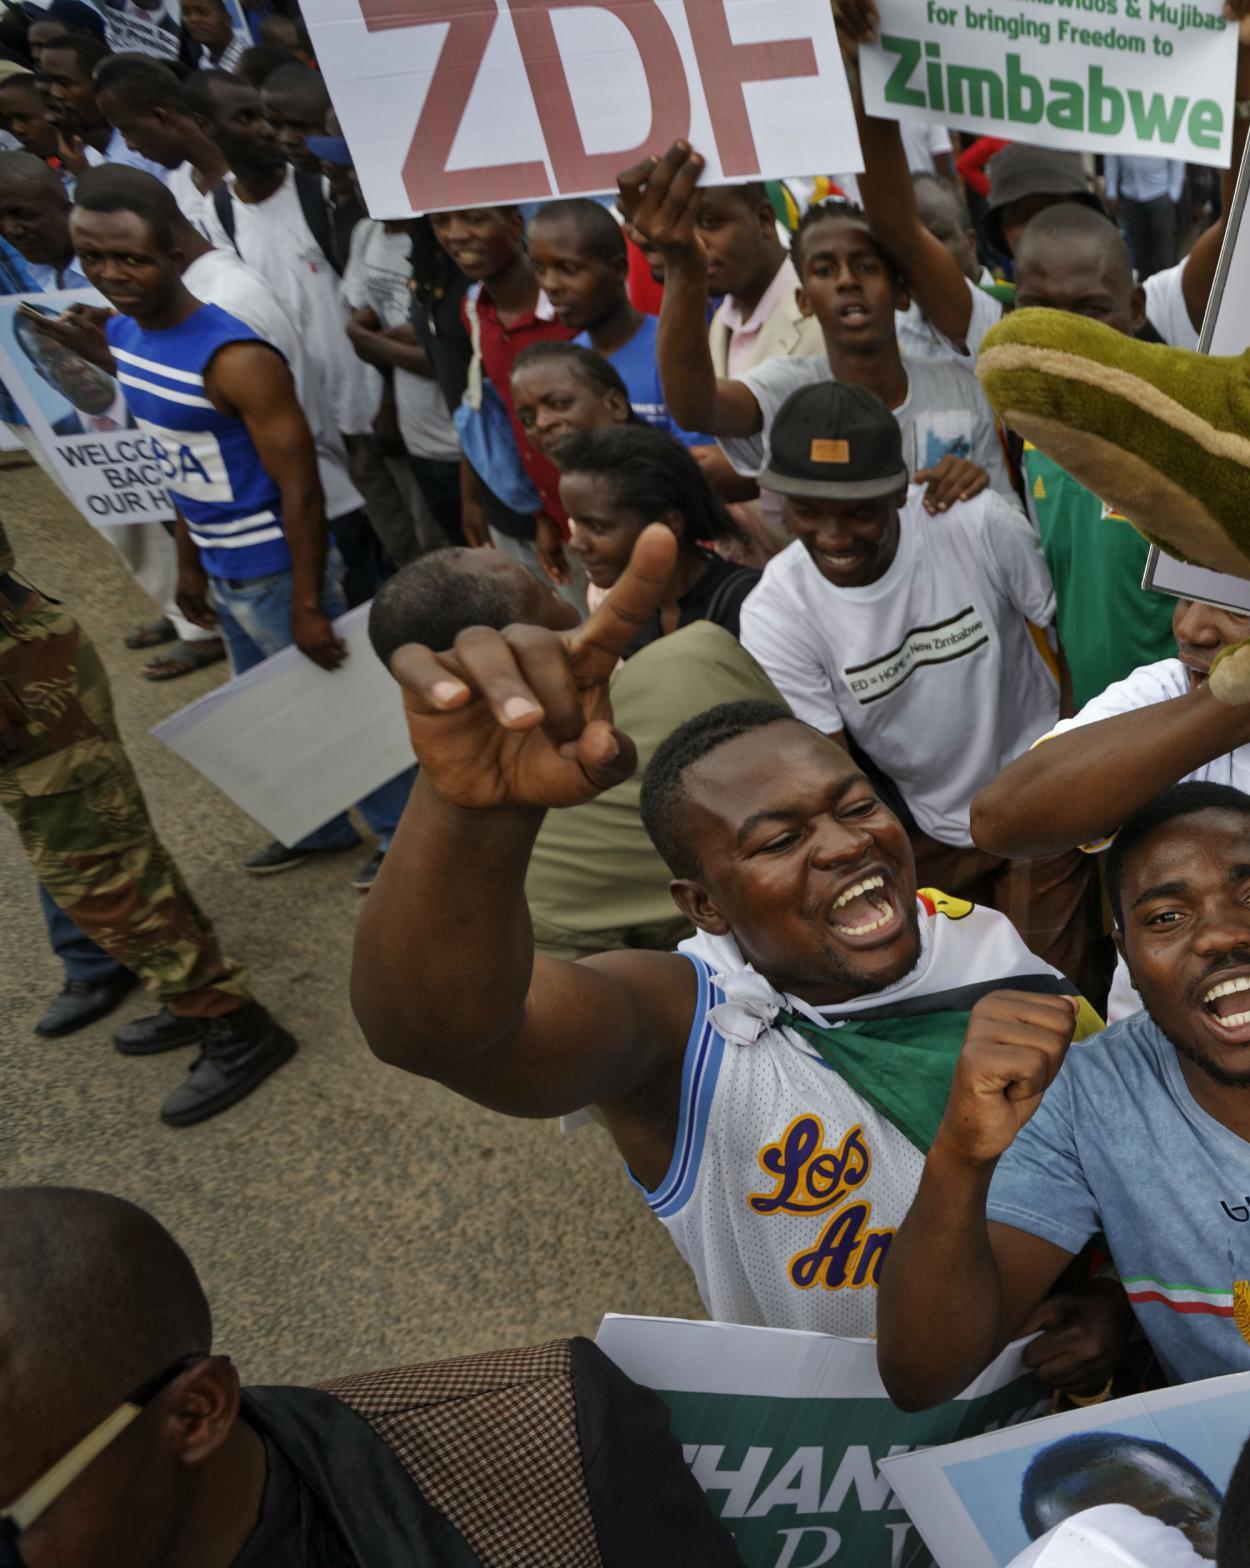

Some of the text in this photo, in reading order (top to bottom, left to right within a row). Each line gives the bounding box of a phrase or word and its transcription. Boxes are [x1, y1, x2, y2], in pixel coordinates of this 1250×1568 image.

[927, 0, 1174, 57] for bringing Freedom to
[1125, 0, 1141, 19] &
[1149, 2, 1227, 31] Mujibas
[358, 0, 820, 212] ZDF
[880, 33, 1224, 150] Zimbabwe
[56, 437, 152, 468] WELCO
[102, 463, 163, 490] BAC
[86, 490, 148, 516] OUR
[850, 678, 869, 693] ED
[879, 659, 908, 684] HOPE
[909, 641, 933, 655] New
[932, 620, 984, 650] Zimbabwe
[747, 1112, 872, 1216] Los
[787, 1201, 897, 1291] An
[682, 1444, 940, 1518] HAN
